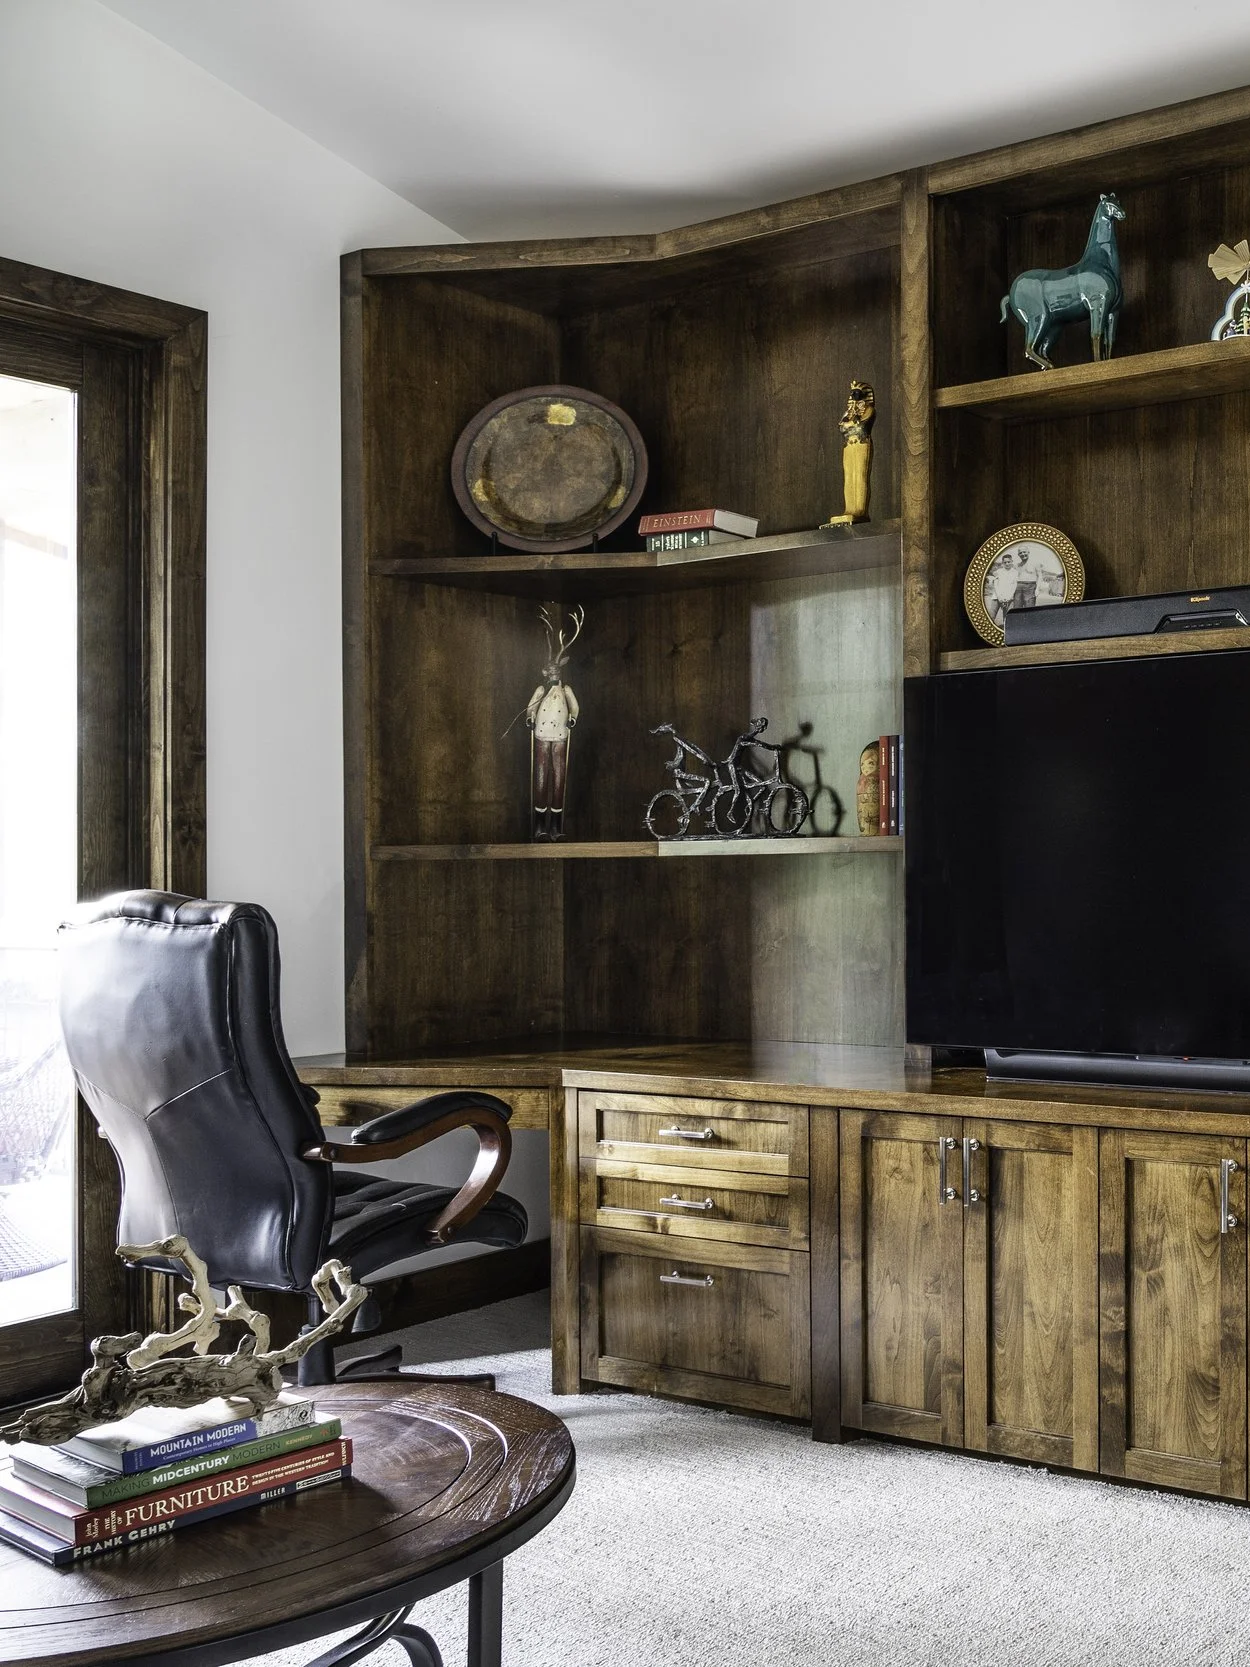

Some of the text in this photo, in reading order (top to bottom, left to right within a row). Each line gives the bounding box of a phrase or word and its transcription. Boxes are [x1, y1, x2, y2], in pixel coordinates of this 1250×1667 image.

[653, 515, 701, 528] EINSTEIN
[150, 1423, 246, 1457] MOUNTAIN MODERN
[102, 1434, 313, 1499] MAKING MIDCENTURY MODERN KENNEDY
[125, 1474, 251, 1527] FURNITURE
[260, 1487, 286, 1500] MILLER
[73, 1520, 175, 1558] FRANK GEHRY
[92, 1517, 100, 1538] Morley
